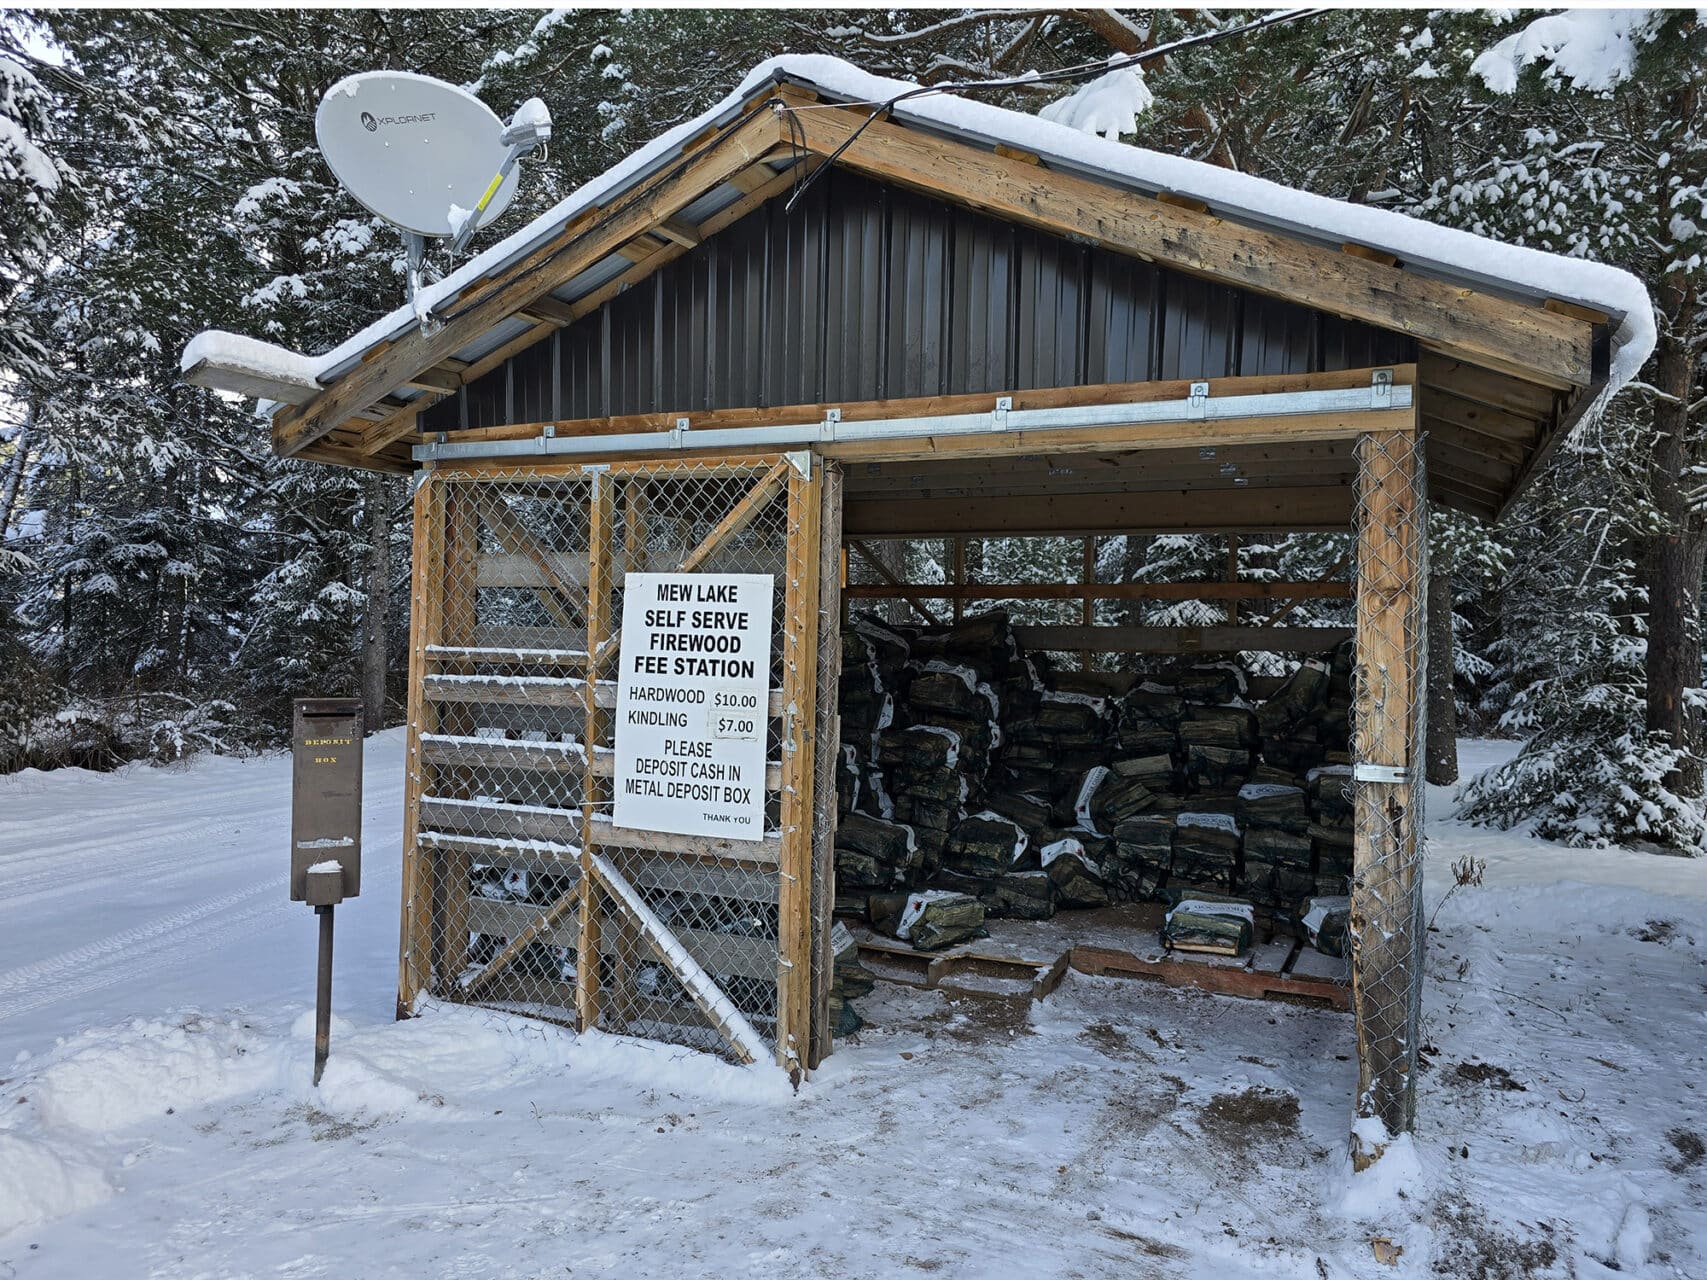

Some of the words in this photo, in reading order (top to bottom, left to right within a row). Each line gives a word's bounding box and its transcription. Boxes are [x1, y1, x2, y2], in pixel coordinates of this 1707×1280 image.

[377, 112, 437, 126] XPLORNET
[657, 583, 693, 602] MEW
[697, 584, 738, 603] LAKE
[645, 609, 687, 628] SELF
[691, 610, 749, 630] SERVE
[650, 633, 741, 654] FIREWOOD
[634, 656, 668, 675] FEE
[673, 657, 755, 679] STATION
[629, 686, 705, 704] HARDWOOD
[714, 692, 757, 708] $10.00
[628, 710, 688, 728] KINDLING
[718, 717, 754, 733] $7.00
[664, 739, 713, 758] PLEASE
[636, 758, 688, 778] DEPOSIT
[690, 762, 725, 781] CASH
[728, 765, 741, 782] IN
[625, 778, 664, 797] METAL
[667, 783, 720, 802] DEPOSIT
[723, 787, 751, 805] BOX
[703, 813, 731, 823] THANK
[733, 816, 751, 825] YOU
